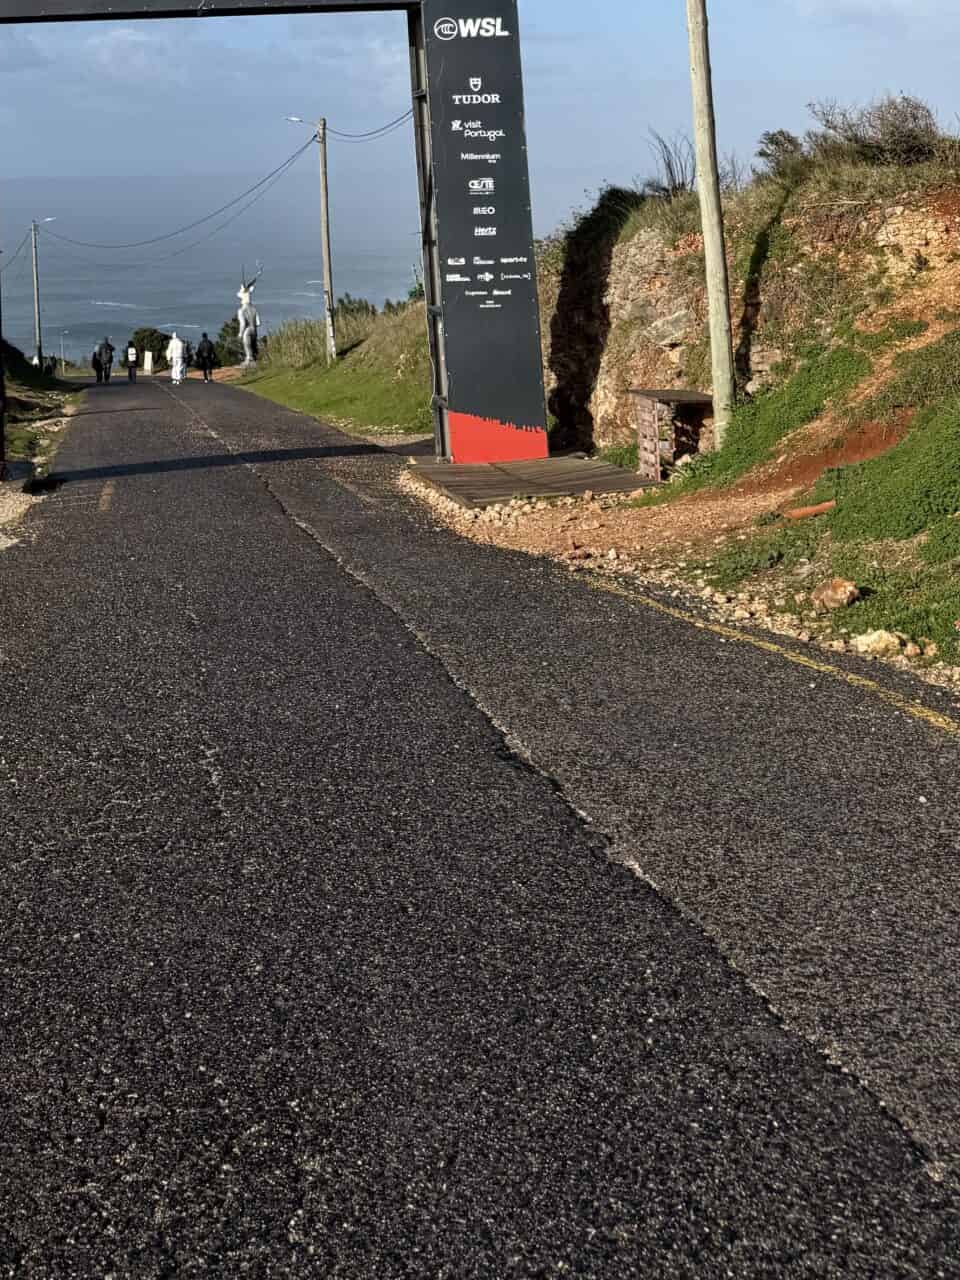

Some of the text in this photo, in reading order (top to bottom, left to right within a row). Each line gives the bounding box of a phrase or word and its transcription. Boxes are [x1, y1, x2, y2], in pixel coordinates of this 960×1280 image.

[458, 17, 510, 37] WSL
[452, 94, 501, 105] TUDOR
[463, 120, 482, 129] visit
[464, 129, 506, 142] Portugal
[460, 151, 501, 160] Millennium
